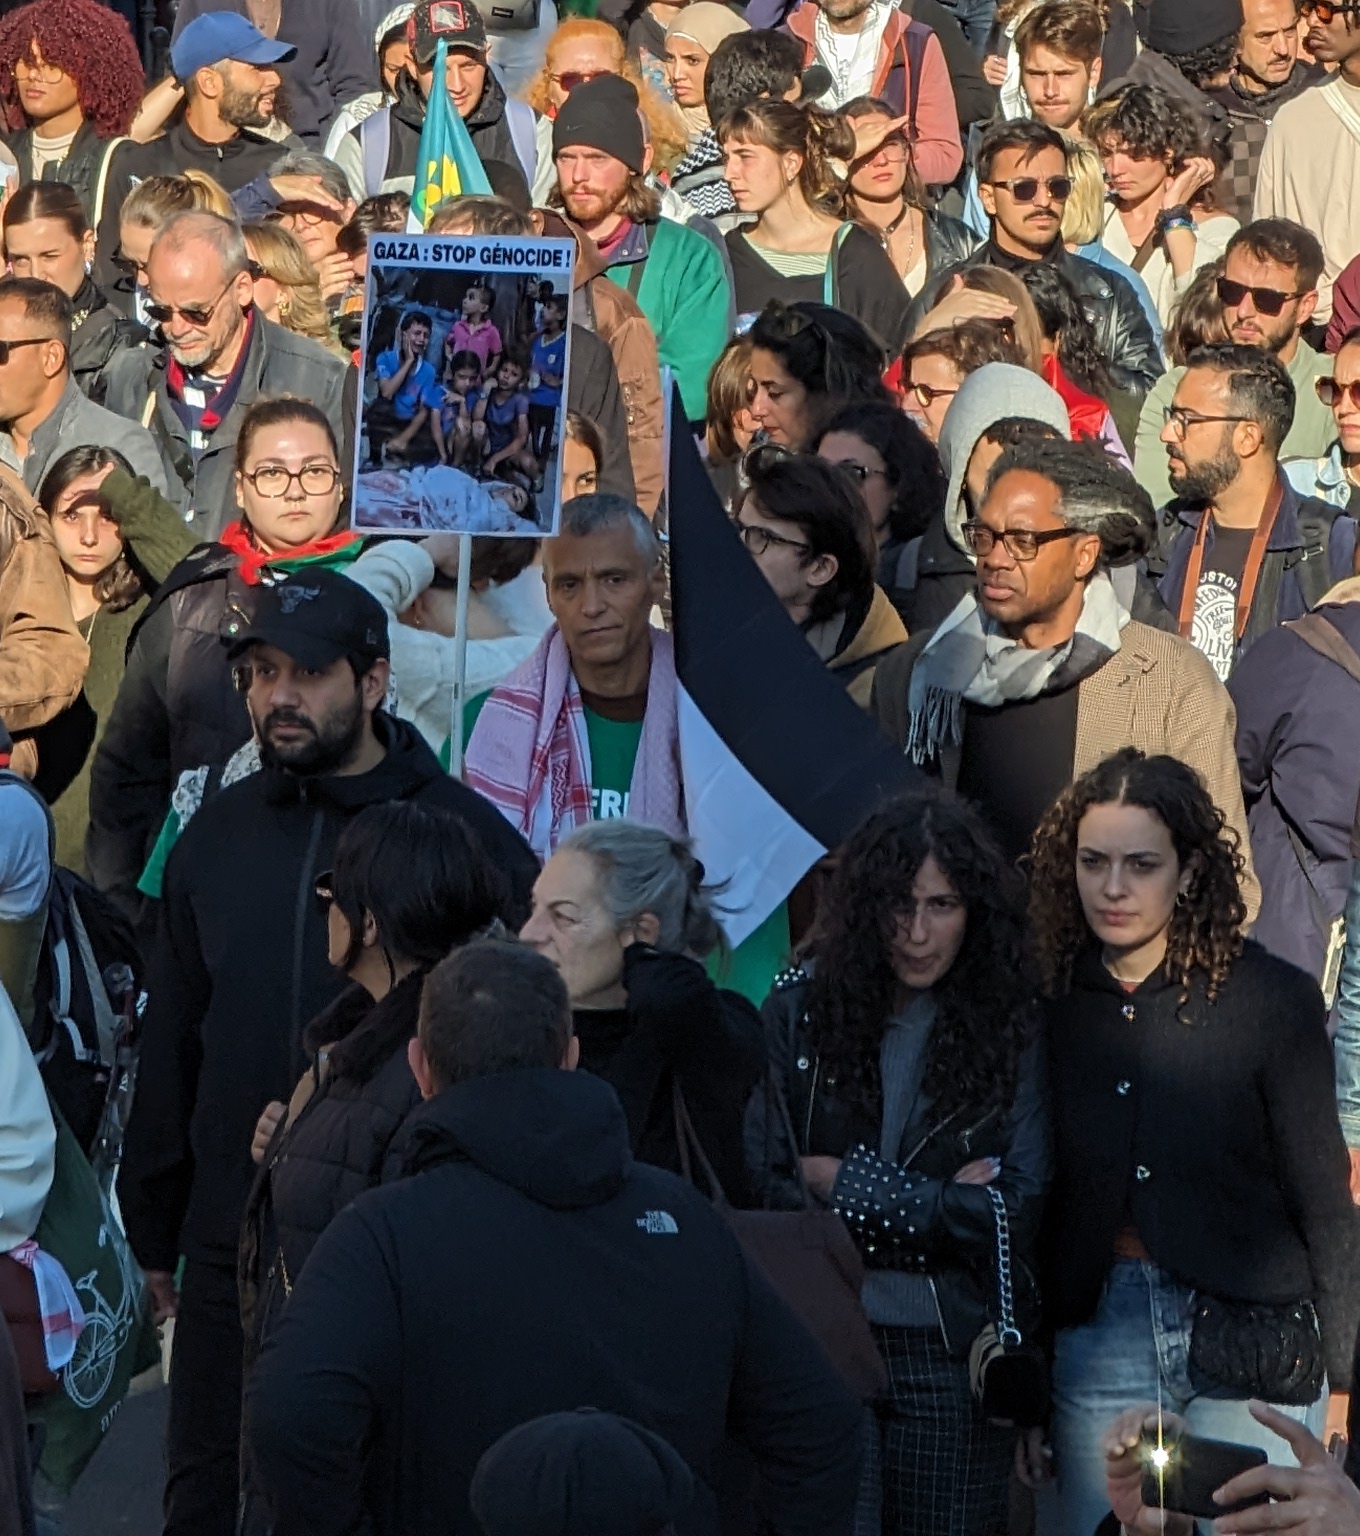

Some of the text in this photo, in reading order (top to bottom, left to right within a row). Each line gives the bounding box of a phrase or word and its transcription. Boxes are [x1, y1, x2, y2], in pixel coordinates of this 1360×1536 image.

[373, 241, 420, 262] GAZA
[431, 244, 476, 264] STOP
[479, 242, 563, 267] GÉNOCIDE
